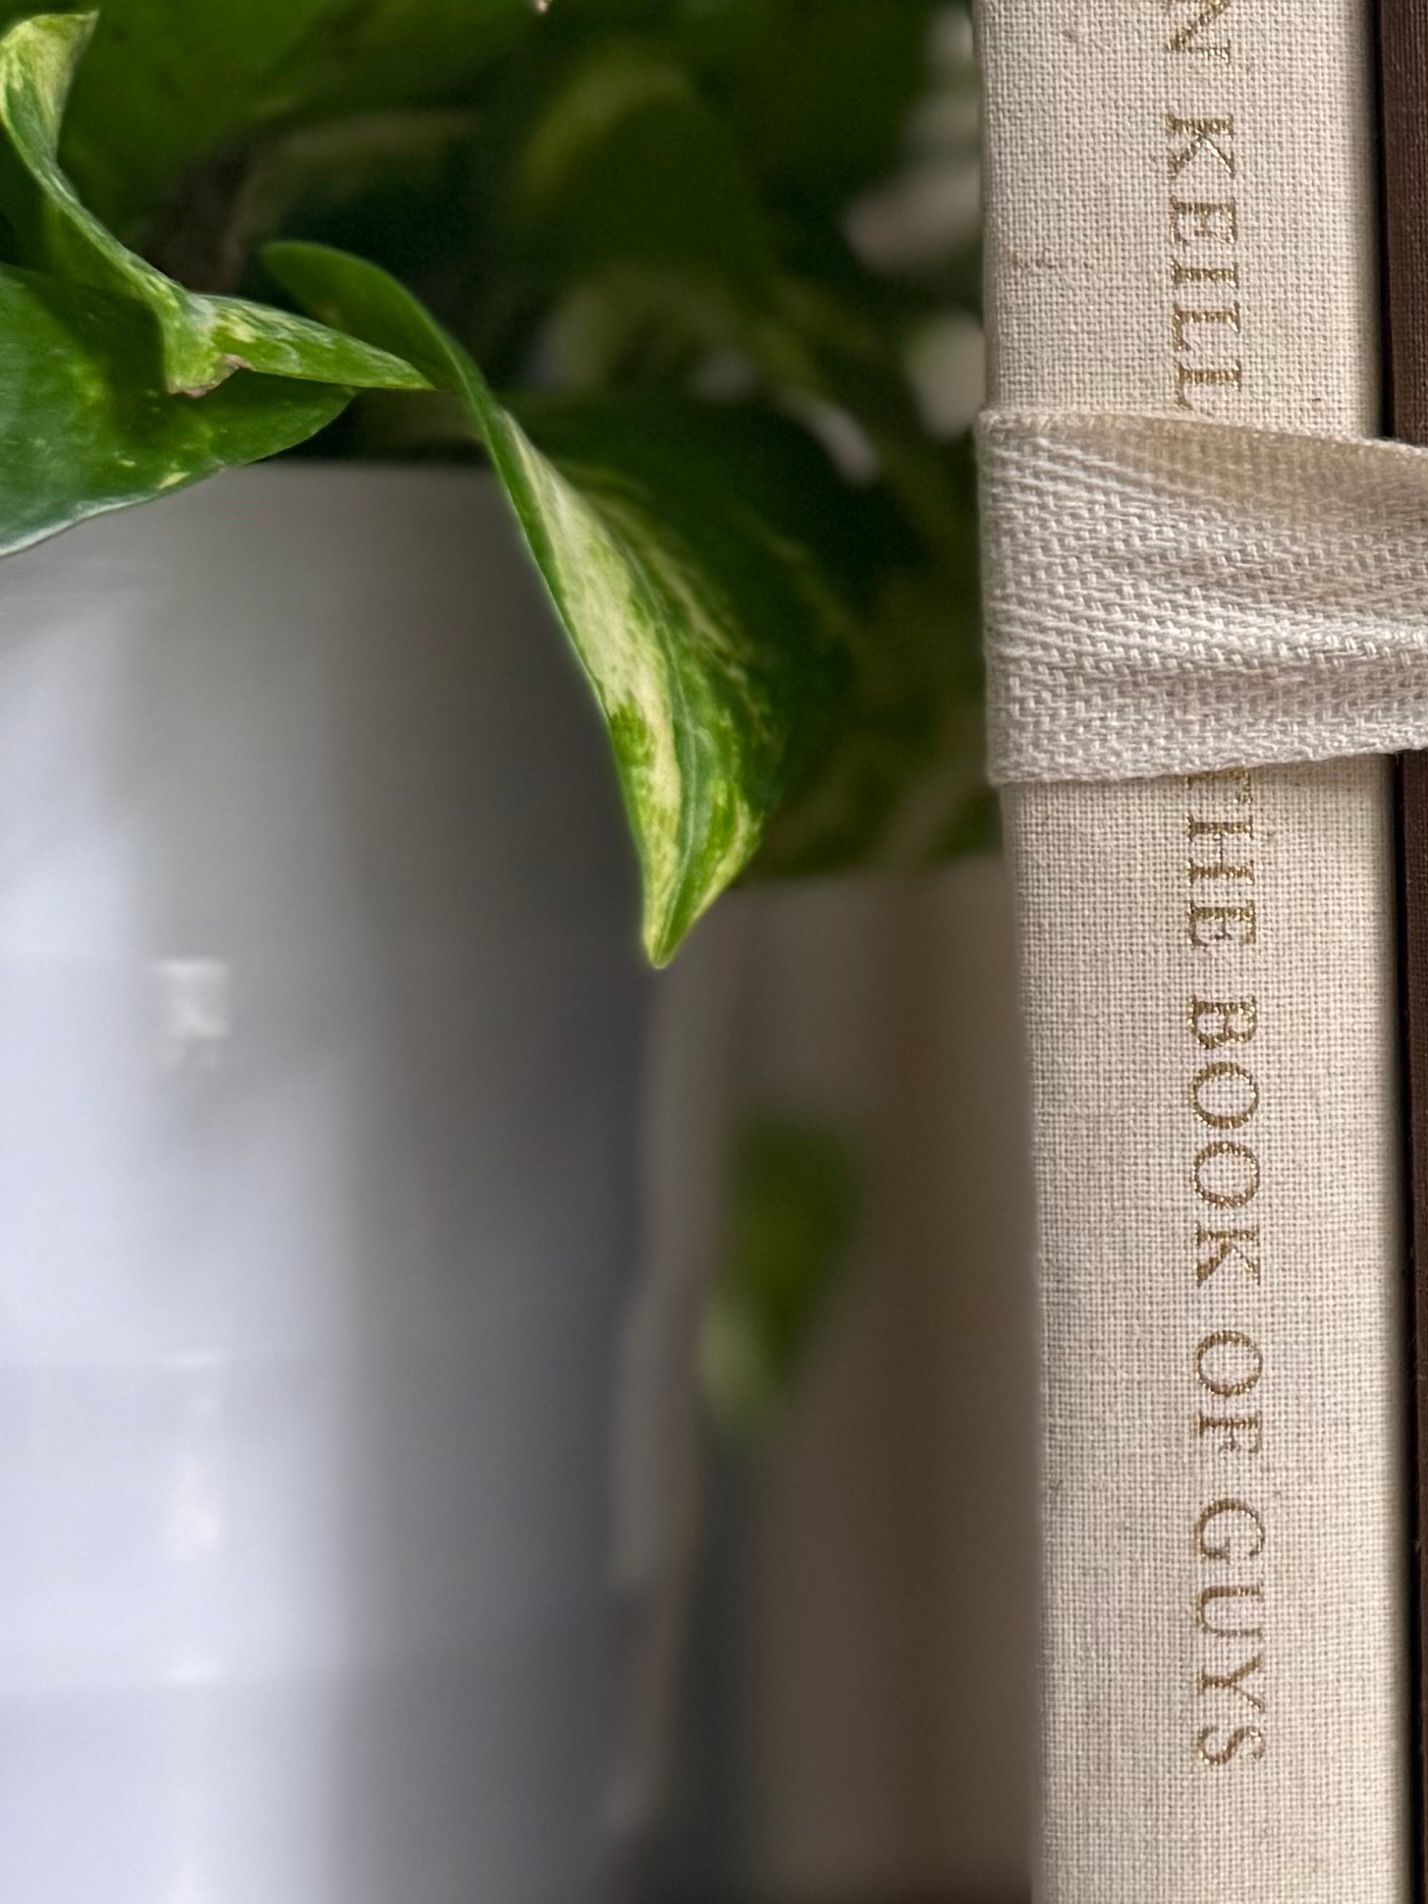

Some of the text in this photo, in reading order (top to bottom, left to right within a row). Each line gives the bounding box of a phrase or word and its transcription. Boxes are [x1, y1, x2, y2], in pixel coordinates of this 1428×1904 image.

[1165, 113, 1244, 414] KEILL
[1187, 995, 1262, 1289] BOOK
[1197, 1329, 1265, 1457] OF
[1197, 1496, 1267, 1769] GUYS
